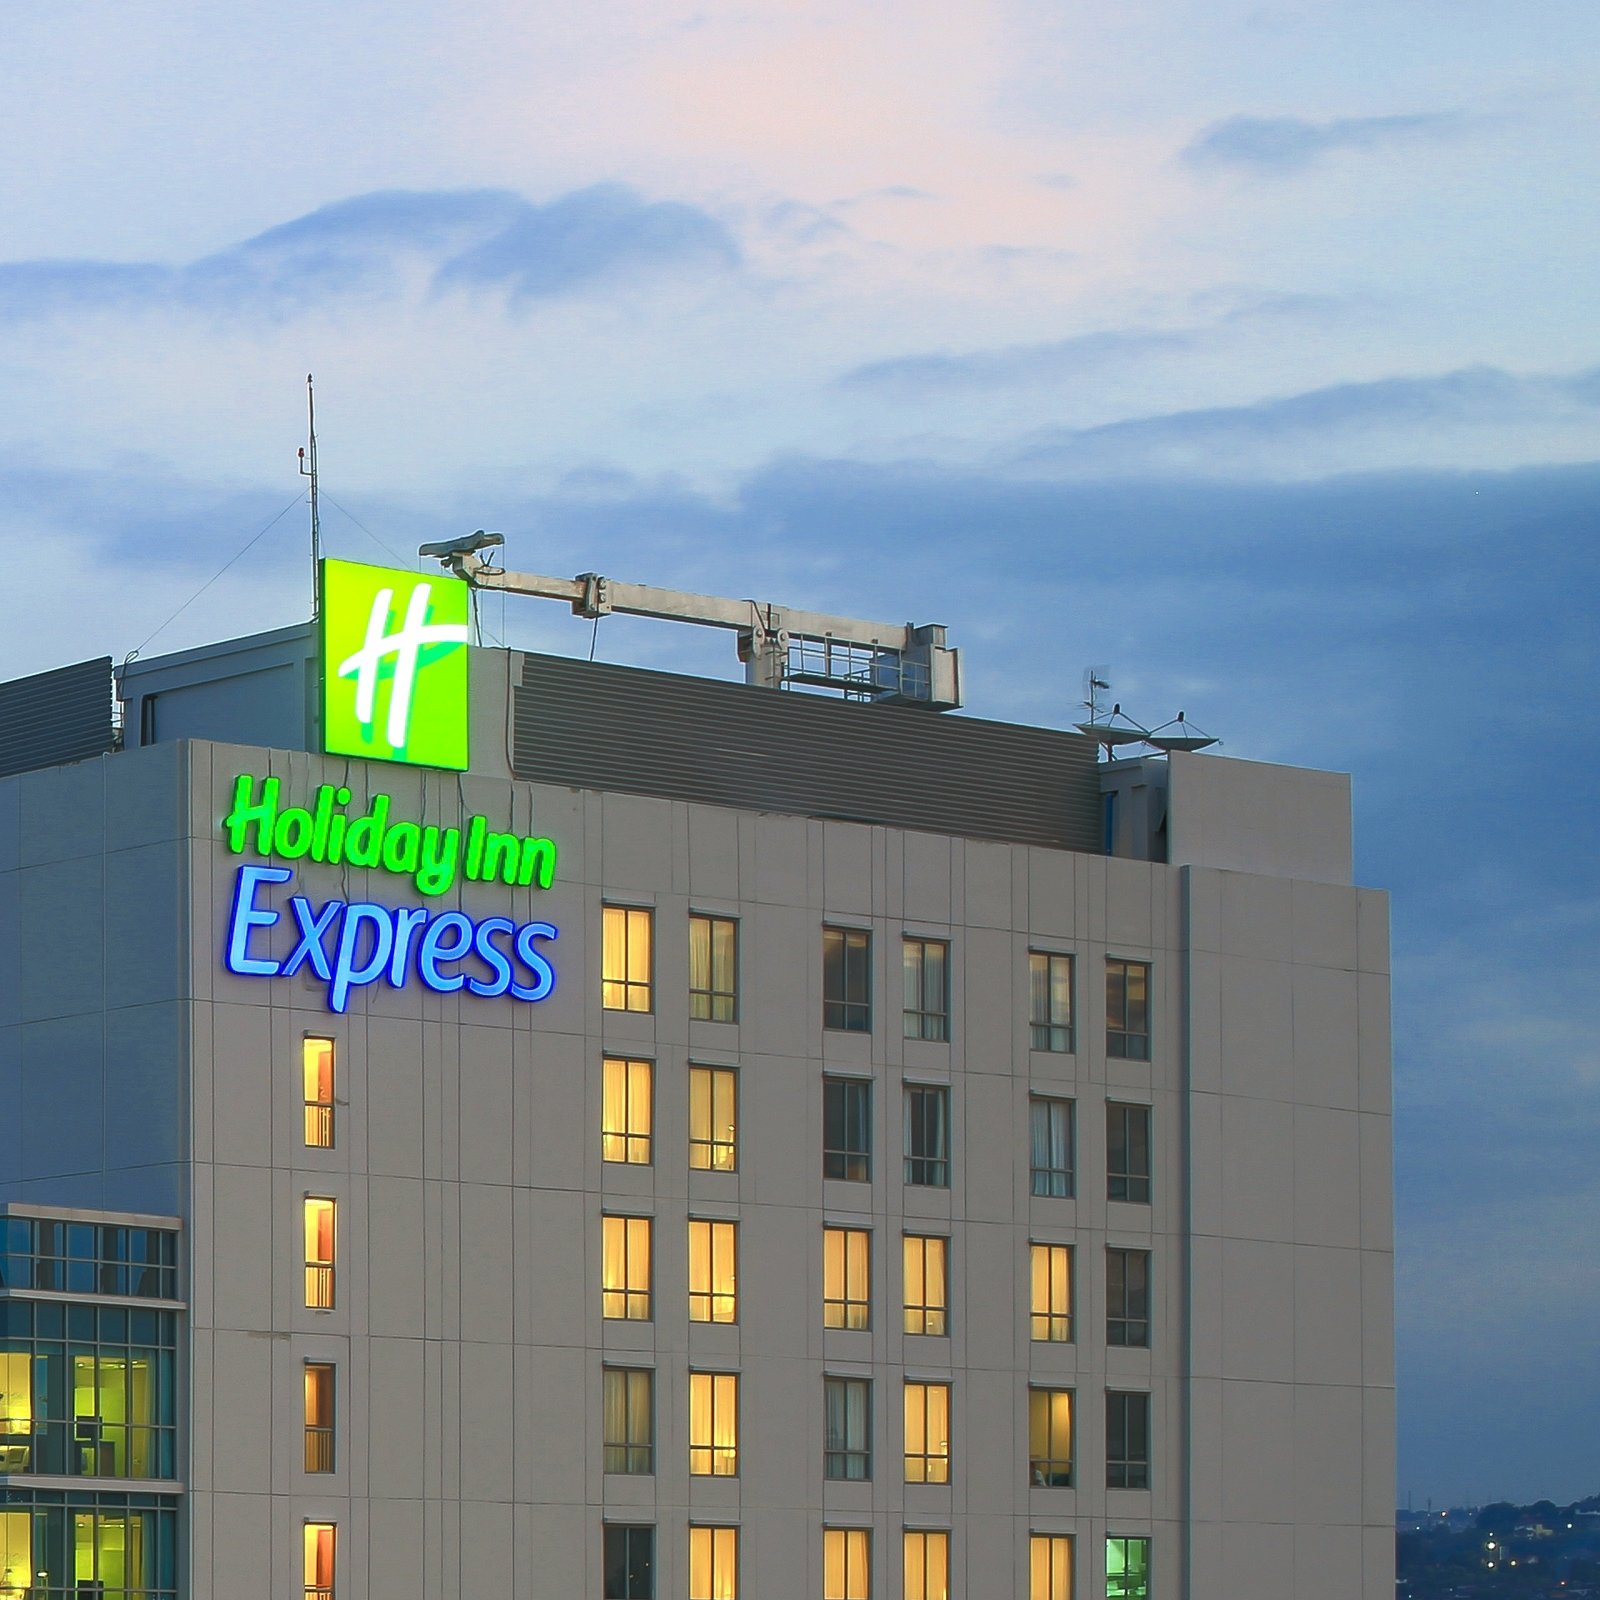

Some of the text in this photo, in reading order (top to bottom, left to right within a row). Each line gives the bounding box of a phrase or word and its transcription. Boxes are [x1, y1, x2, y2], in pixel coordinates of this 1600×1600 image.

[224, 774, 557, 896] Holiday Inn
[226, 864, 558, 1014] Express
